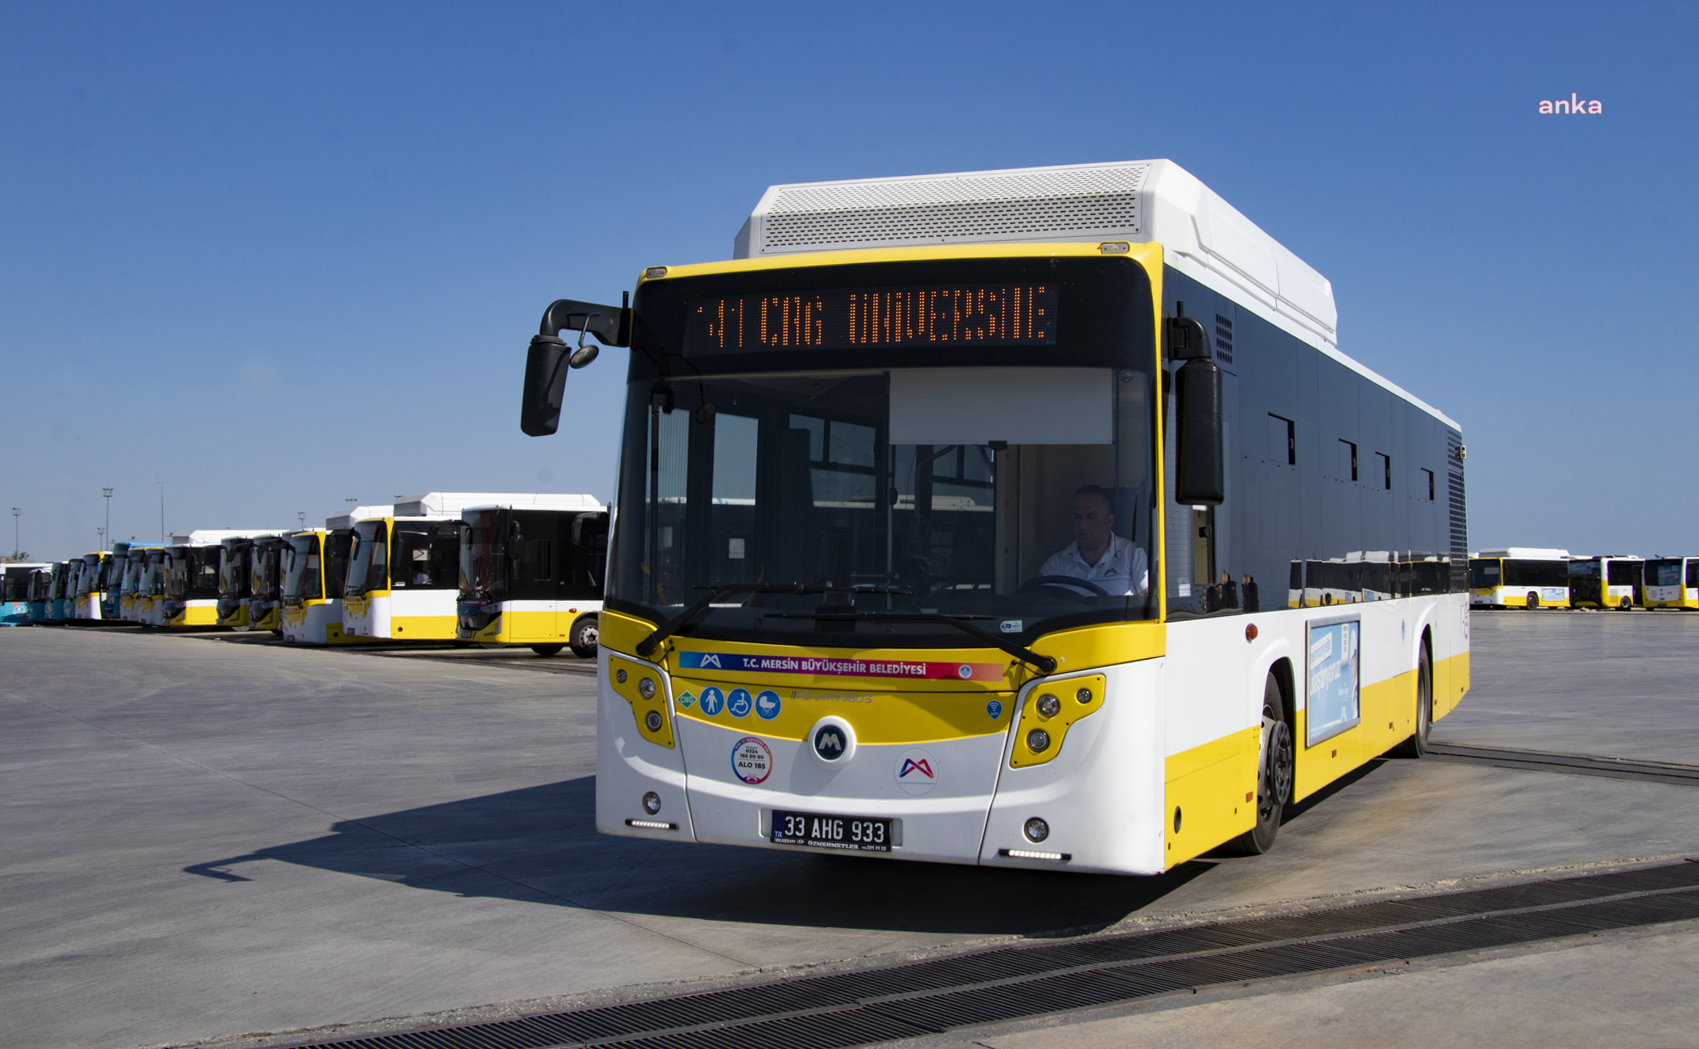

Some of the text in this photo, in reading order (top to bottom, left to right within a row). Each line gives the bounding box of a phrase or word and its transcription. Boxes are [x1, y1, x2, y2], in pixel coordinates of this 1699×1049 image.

[743, 658, 927, 676] T.C. MERSİN BÜYÜKŞEHİR BELEDİYESİ
[738, 761, 753, 769] ALO
[774, 830, 782, 838] TR
[784, 816, 884, 843] 33 AHG 933
